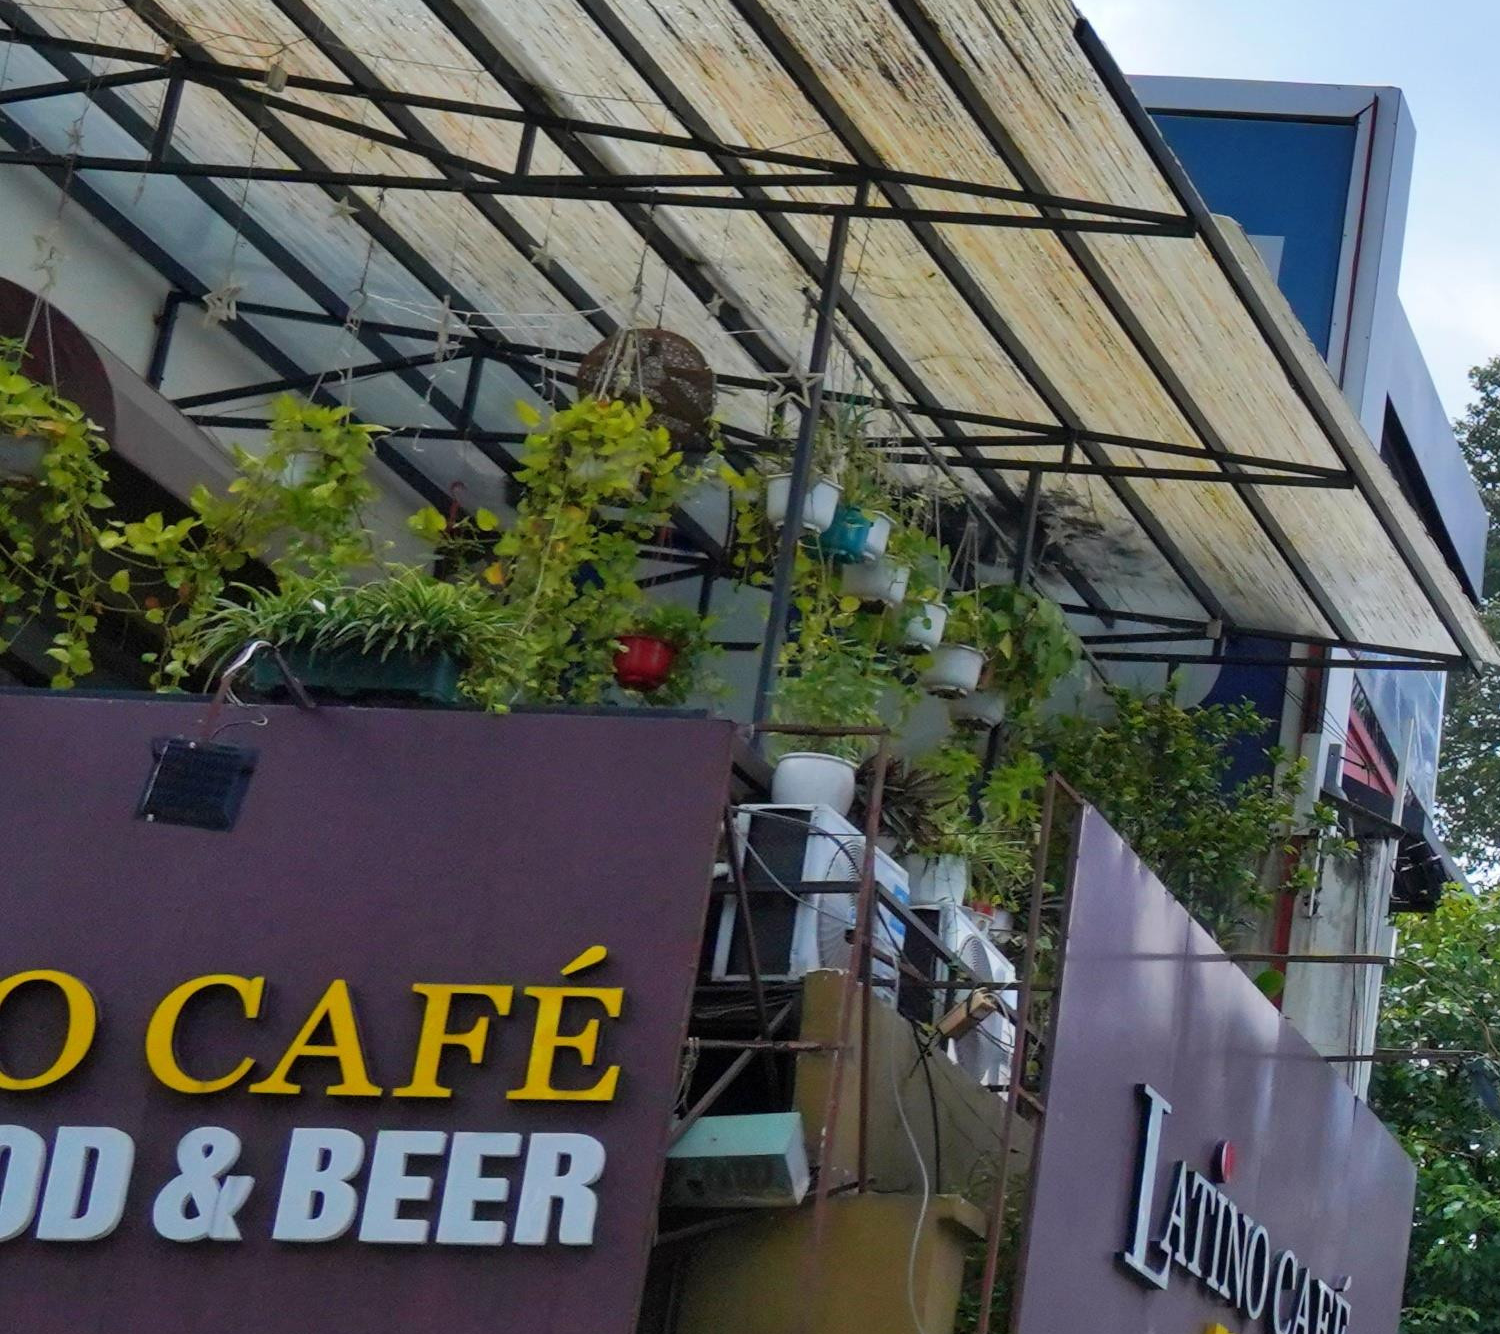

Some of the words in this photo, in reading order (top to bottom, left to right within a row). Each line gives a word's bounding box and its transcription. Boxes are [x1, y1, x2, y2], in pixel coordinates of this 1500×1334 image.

[145, 946, 625, 1101] CAFÉ
[153, 1127, 255, 1243] &
[273, 1128, 606, 1246] BEER
[1115, 1084, 1270, 1321] LATINO
